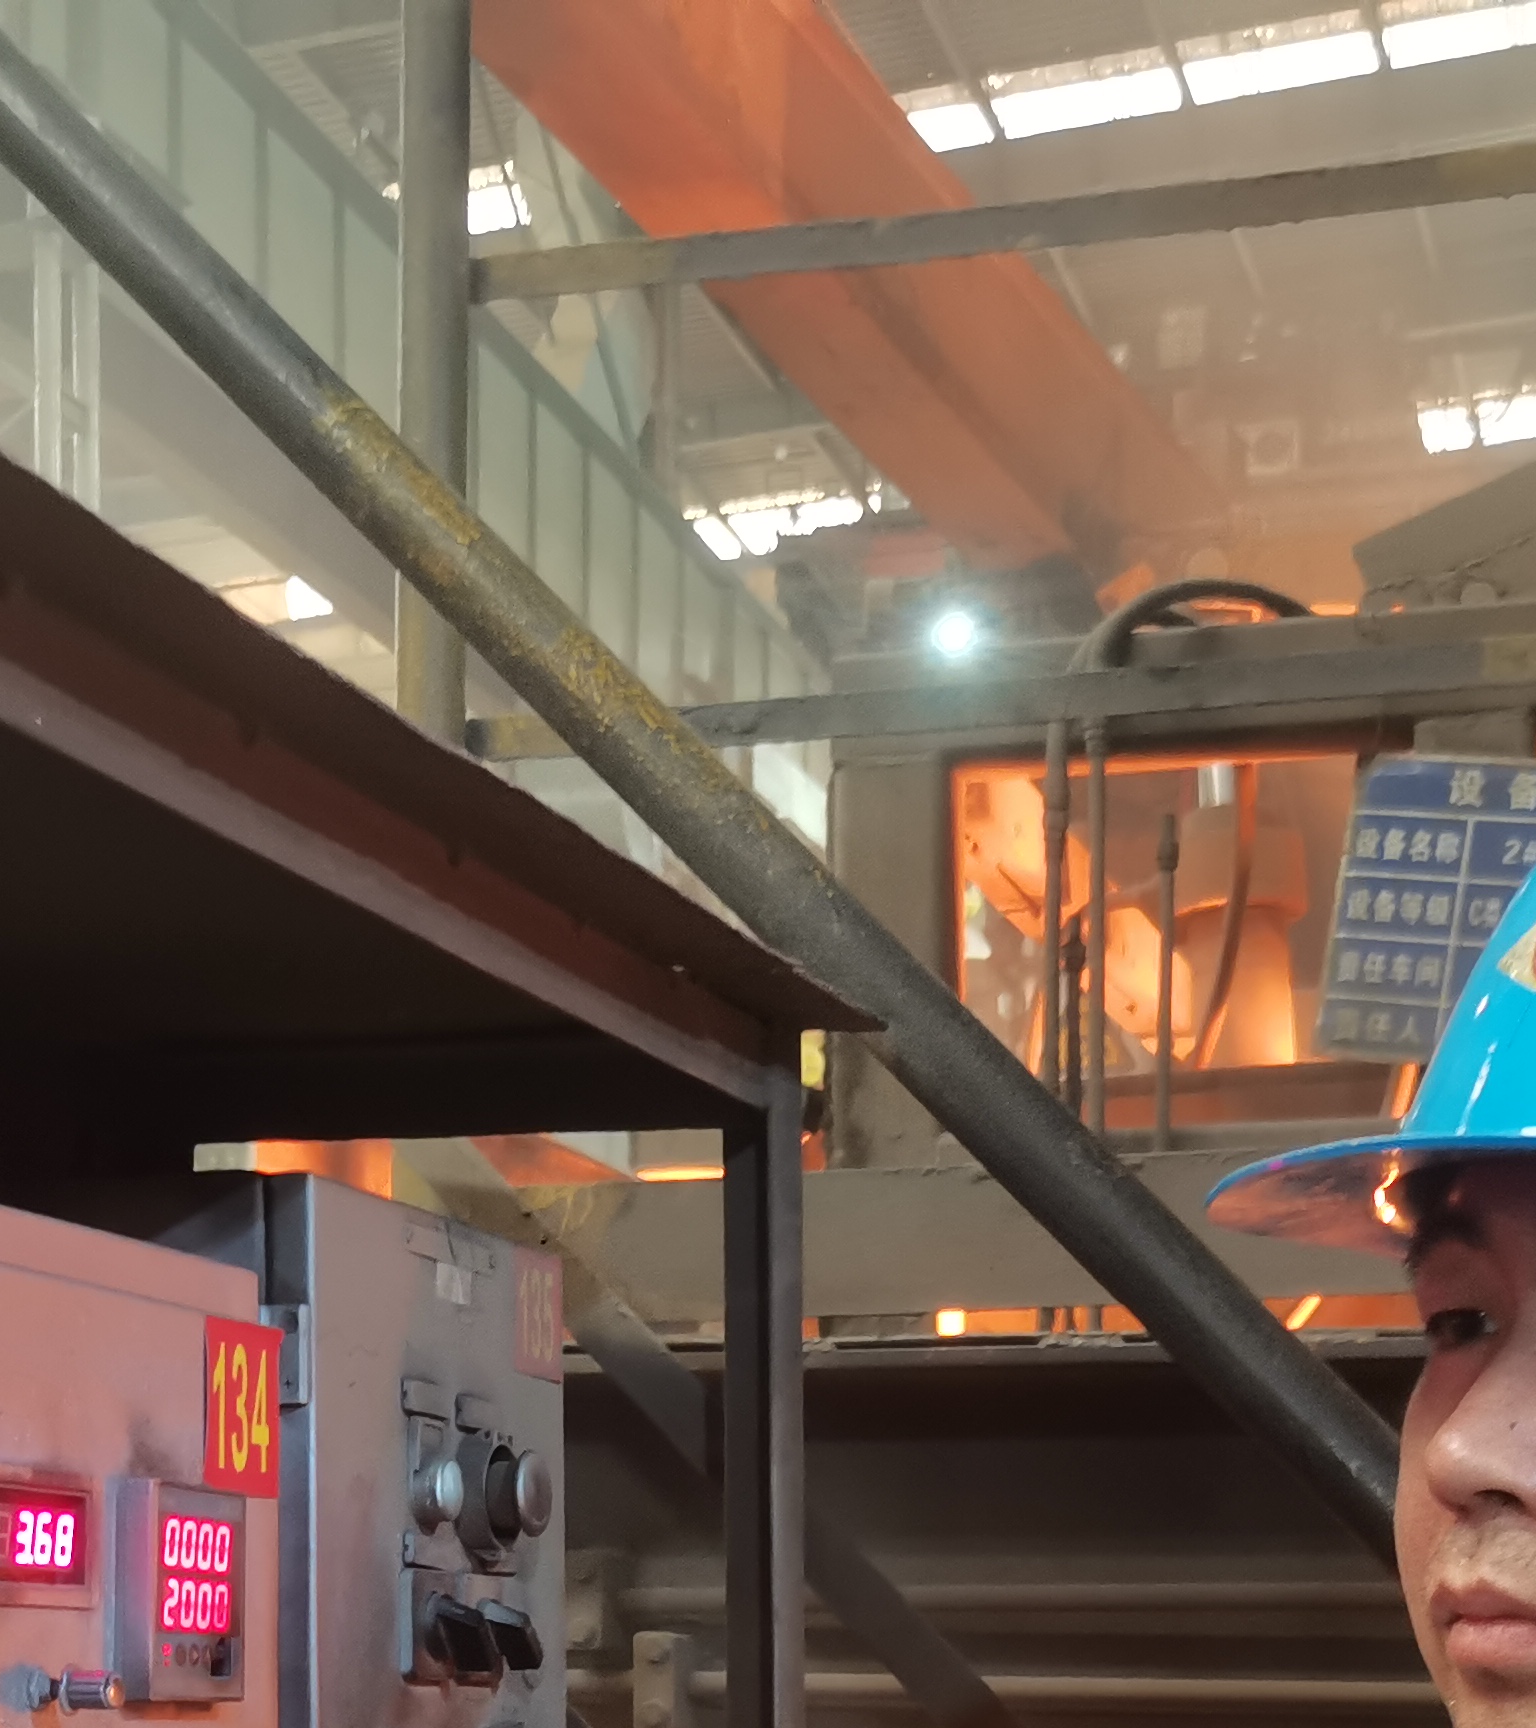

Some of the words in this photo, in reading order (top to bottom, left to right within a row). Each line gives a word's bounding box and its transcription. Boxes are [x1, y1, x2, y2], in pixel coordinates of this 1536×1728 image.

[520, 1268, 554, 1362] 135
[213, 1342, 270, 1473] 134
[164, 1518, 231, 1573] 0000
[164, 1578, 229, 1630] 2000
